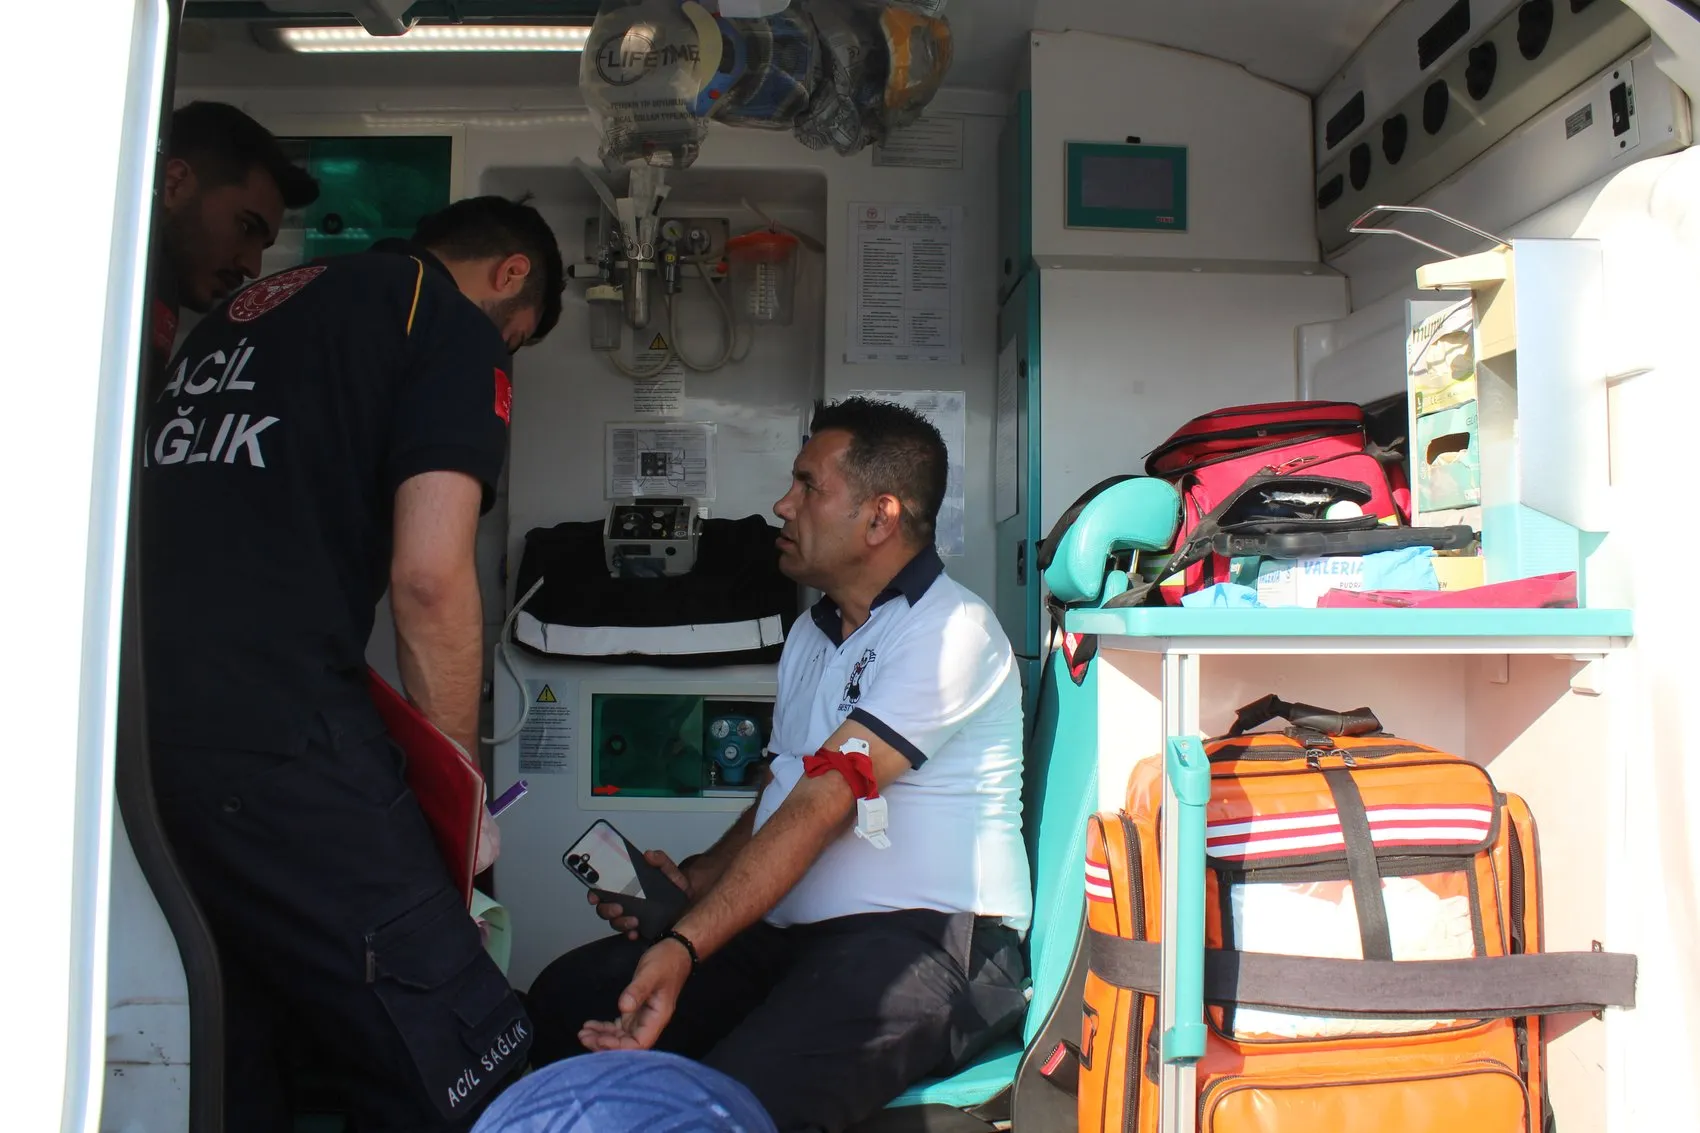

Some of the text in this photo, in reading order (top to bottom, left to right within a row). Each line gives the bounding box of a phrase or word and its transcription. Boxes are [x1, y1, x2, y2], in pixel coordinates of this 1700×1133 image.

[156, 337, 255, 403] ACİL
[144, 405, 280, 468] ĞLIK
[447, 1020, 528, 1108] ACİL SAĞLIK
